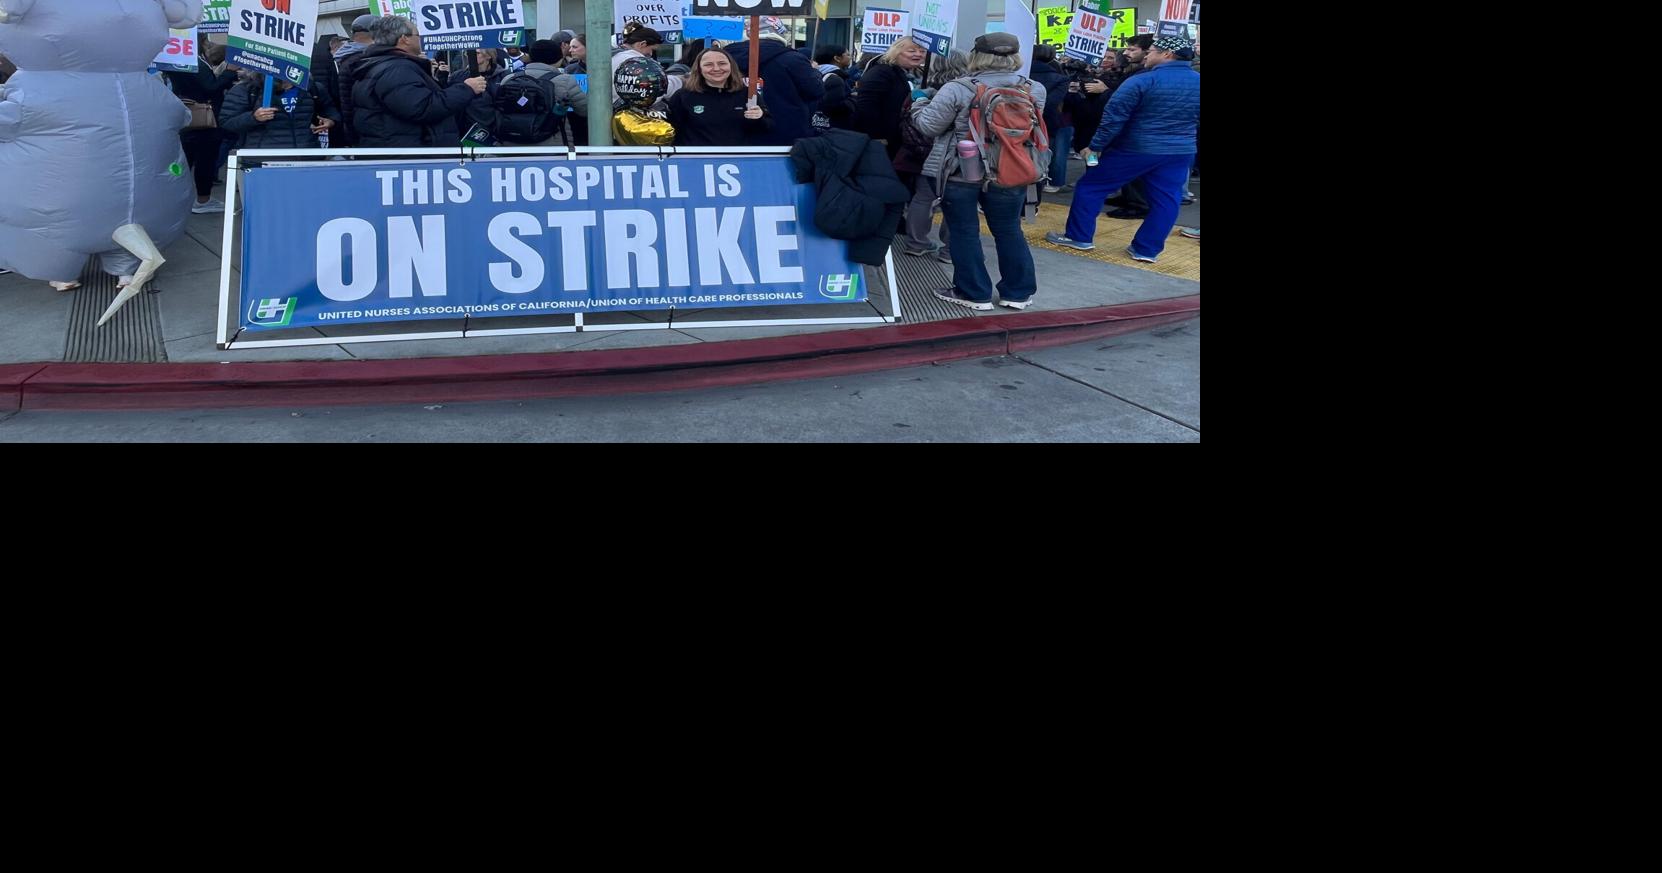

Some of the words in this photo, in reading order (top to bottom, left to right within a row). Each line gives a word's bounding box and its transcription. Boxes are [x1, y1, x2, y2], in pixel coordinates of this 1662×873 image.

[421, 0, 517, 31] STRIKE
[636, 4, 666, 13] OVER
[873, 12, 901, 27] ULP
[240, 9, 306, 47] STRIKE
[1081, 12, 1107, 33] ULP
[864, 32, 903, 46] STRIK
[1068, 34, 1105, 56] STRIKE
[617, 74, 638, 84] HAPPY
[375, 168, 472, 206] THIS
[491, 164, 689, 202] HOSPITAL
[703, 163, 741, 198] IS
[316, 214, 447, 302] ON
[487, 205, 804, 294] STRIKE
[318, 310, 362, 321] UNITED
[364, 307, 411, 317] NURSES
[413, 303, 499, 314] ASSOCIATIONS
[502, 302, 517, 311] OF
[519, 297, 627, 310] CALIFORNIA/UNION
[628, 297, 643, 306] OF
[645, 295, 687, 305] HEALTH
[688, 294, 718, 303] CARE
[719, 291, 804, 302] PROFESSIONALS
